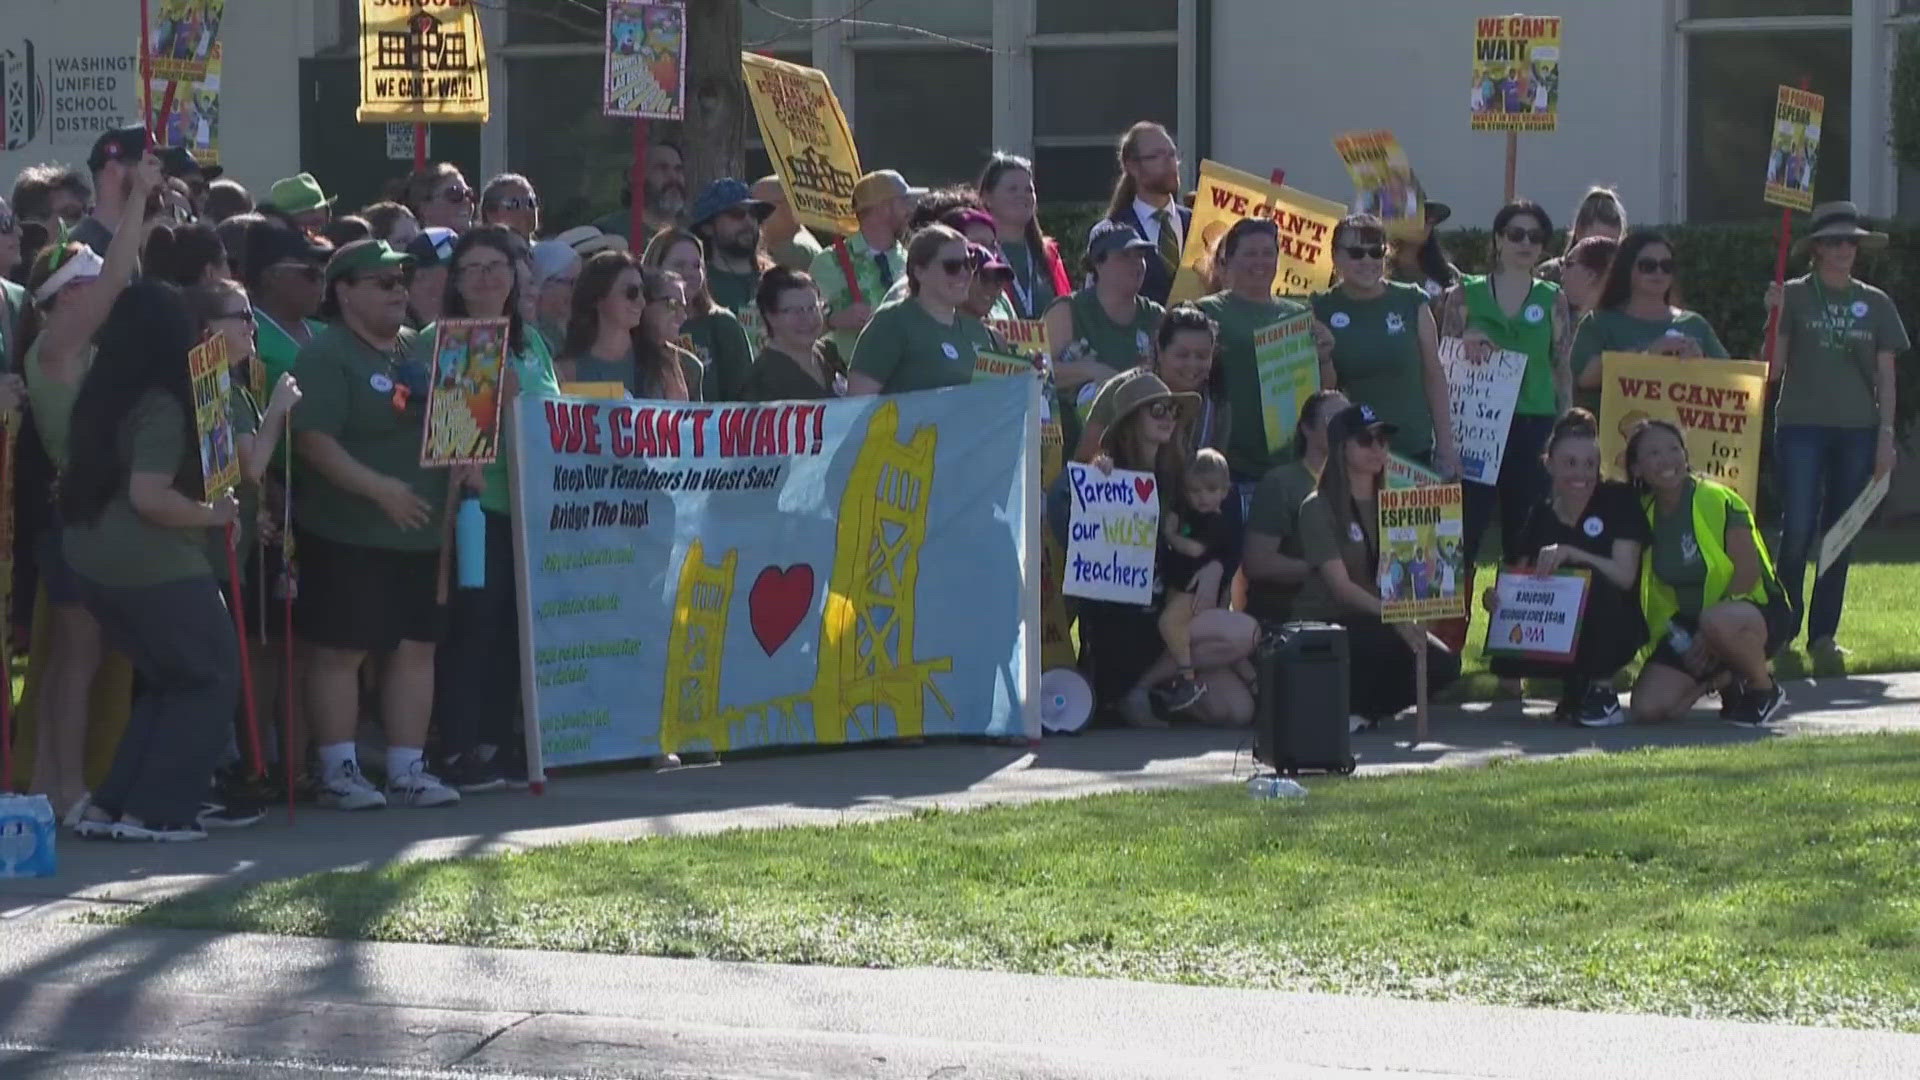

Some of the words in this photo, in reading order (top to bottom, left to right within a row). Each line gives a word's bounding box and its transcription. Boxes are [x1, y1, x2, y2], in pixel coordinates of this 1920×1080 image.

[1478, 17, 1504, 38] WE
[1509, 17, 1561, 39] CAN'T
[1477, 39, 1528, 60] WAIT
[55, 56, 136, 72] WASHINGT
[55, 77, 117, 92] UNIFIED
[375, 77, 395, 97] WE
[398, 77, 435, 98] CAN'T
[55, 97, 118, 112] SCHOOL
[55, 116, 125, 131] DISTRICT
[1210, 186, 1249, 217] WE
[1279, 232, 1322, 264] AIT
[1283, 267, 1313, 289] for
[1618, 376, 1662, 400] WE
[1667, 382, 1750, 411] CAN'T
[545, 400, 601, 454] WE
[609, 406, 713, 459] CAN'T
[718, 404, 827, 459] WAIT!
[1676, 406, 1748, 434] WAIT
[1711, 440, 1742, 458] for
[553, 464, 585, 492] Keep
[585, 463, 610, 490] Our
[609, 464, 683, 491] Teachers
[682, 467, 702, 491] In
[702, 467, 745, 491] West
[744, 464, 782, 489] Sac!
[1706, 461, 1740, 479] the
[1070, 467, 1134, 513] Parents
[1380, 490, 1398, 509] NO
[1400, 487, 1461, 508] PODEMOS
[550, 502, 590, 531] Bridge
[592, 500, 619, 527] The
[620, 498, 649, 529] Gap!
[1381, 506, 1441, 527] ESPERAR
[1072, 521, 1101, 543] our
[1072, 550, 1149, 588] teachers
